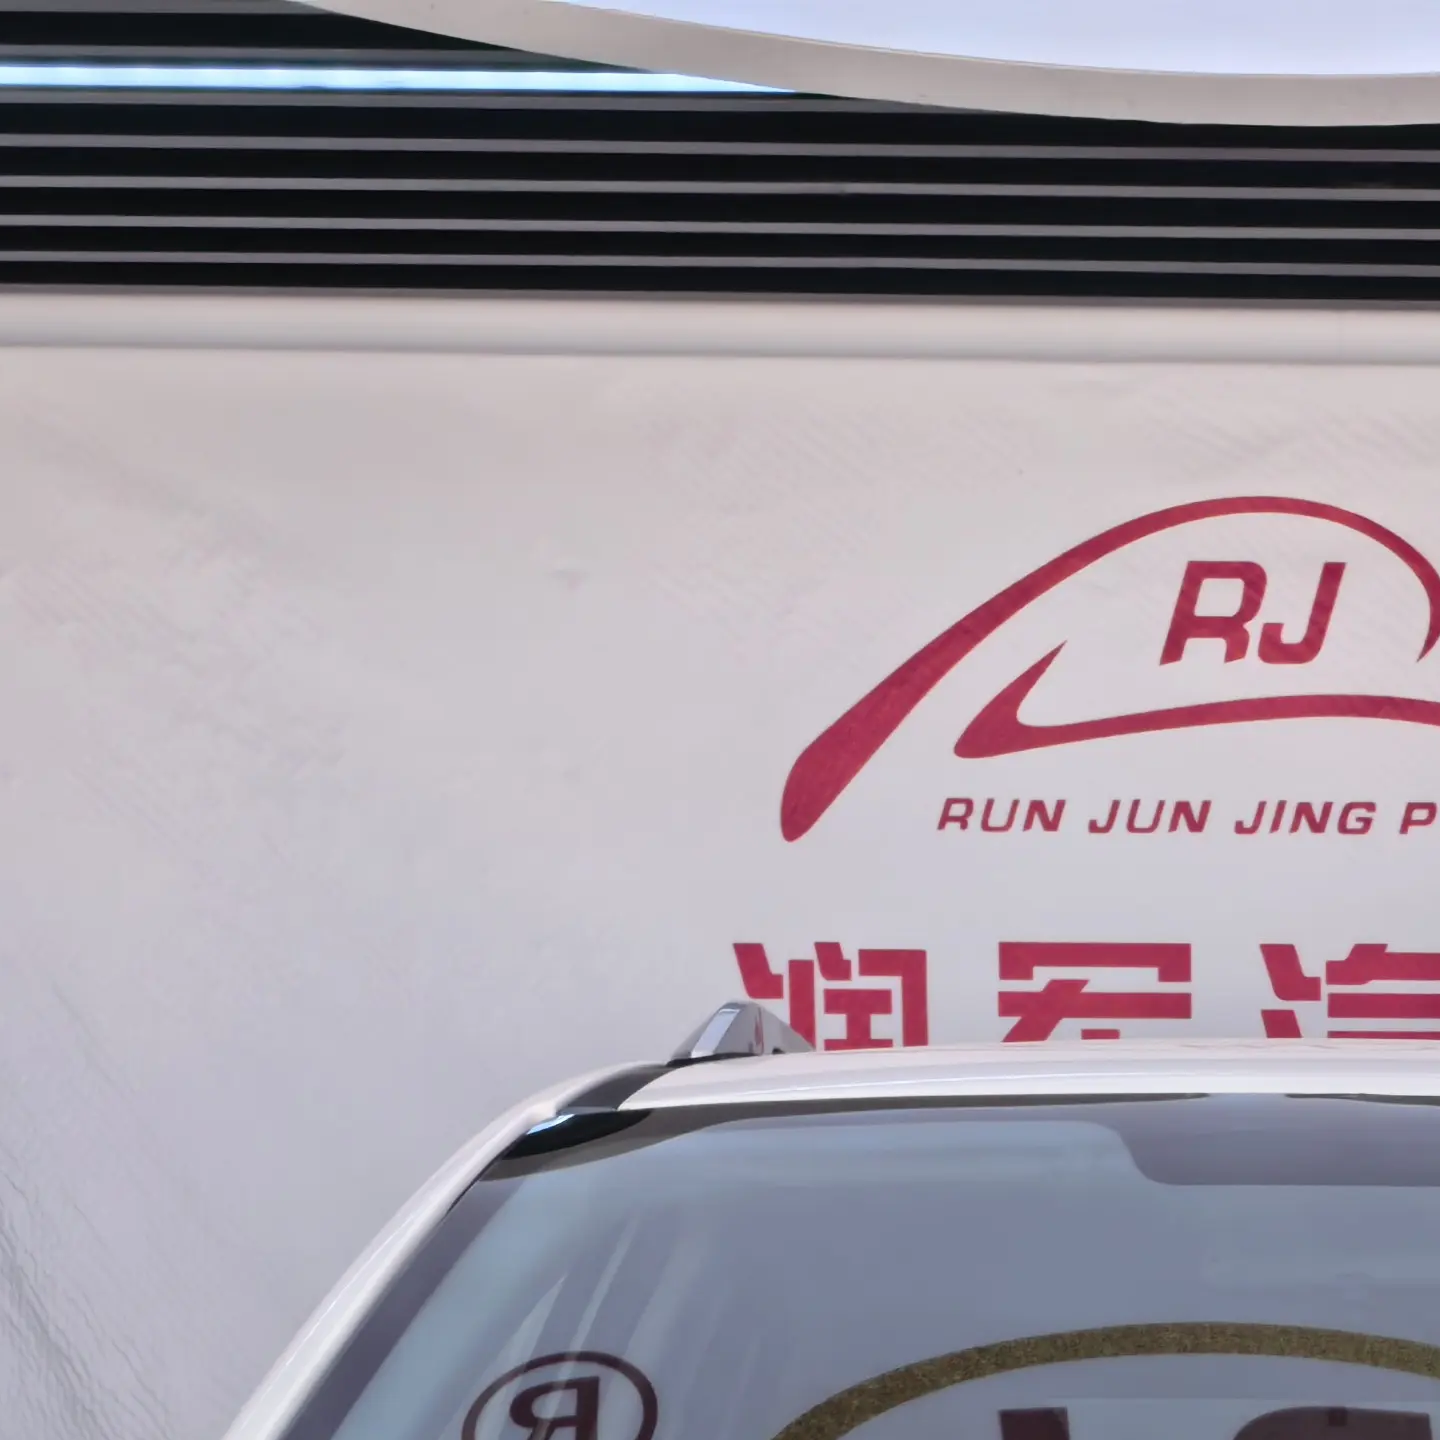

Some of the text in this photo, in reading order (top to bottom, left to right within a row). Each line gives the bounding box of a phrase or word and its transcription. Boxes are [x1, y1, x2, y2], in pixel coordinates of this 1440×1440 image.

[1159, 560, 1347, 666] RJ
[937, 797, 1067, 833] RUN
[1087, 799, 1212, 834] JUN
[1234, 800, 1377, 836] JING
